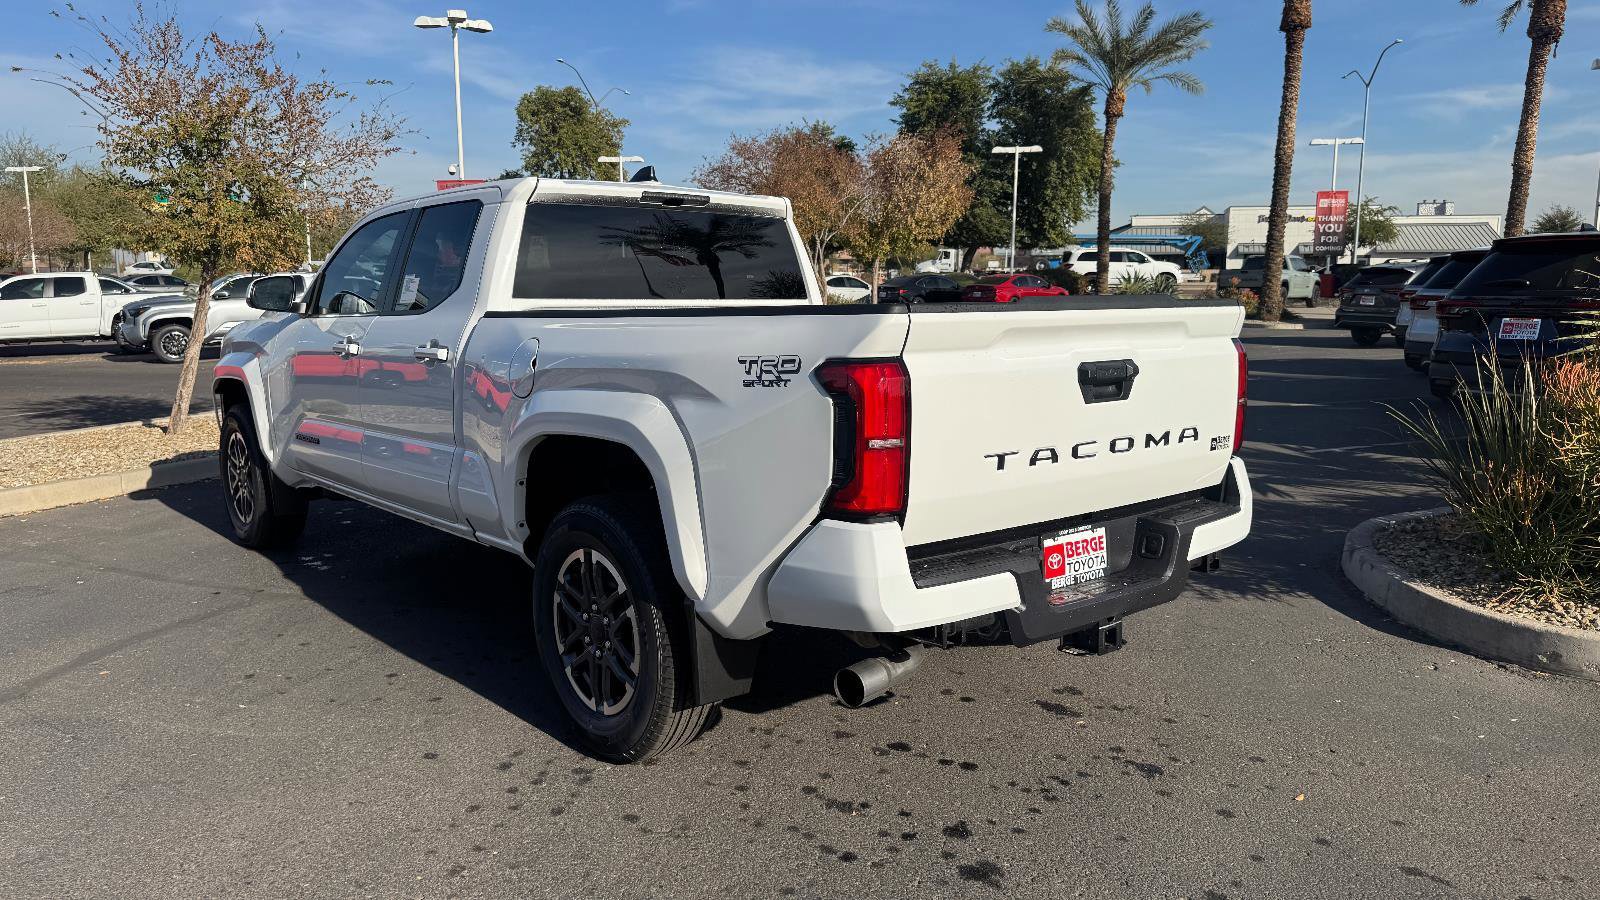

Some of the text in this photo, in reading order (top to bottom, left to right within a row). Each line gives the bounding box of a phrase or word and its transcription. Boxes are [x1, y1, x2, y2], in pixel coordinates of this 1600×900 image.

[1317, 223, 1343, 233] YOU
[1320, 235, 1339, 243] FOR
[1514, 322, 1538, 330] BERGE
[738, 354, 802, 380] TRD
[742, 378, 792, 388] SPORT
[983, 426, 1199, 471] TACOMA
[1065, 534, 1105, 559] BERGE
[1066, 554, 1106, 574] TOYOTA
[1051, 568, 1105, 590] BERGE TOYOTA
